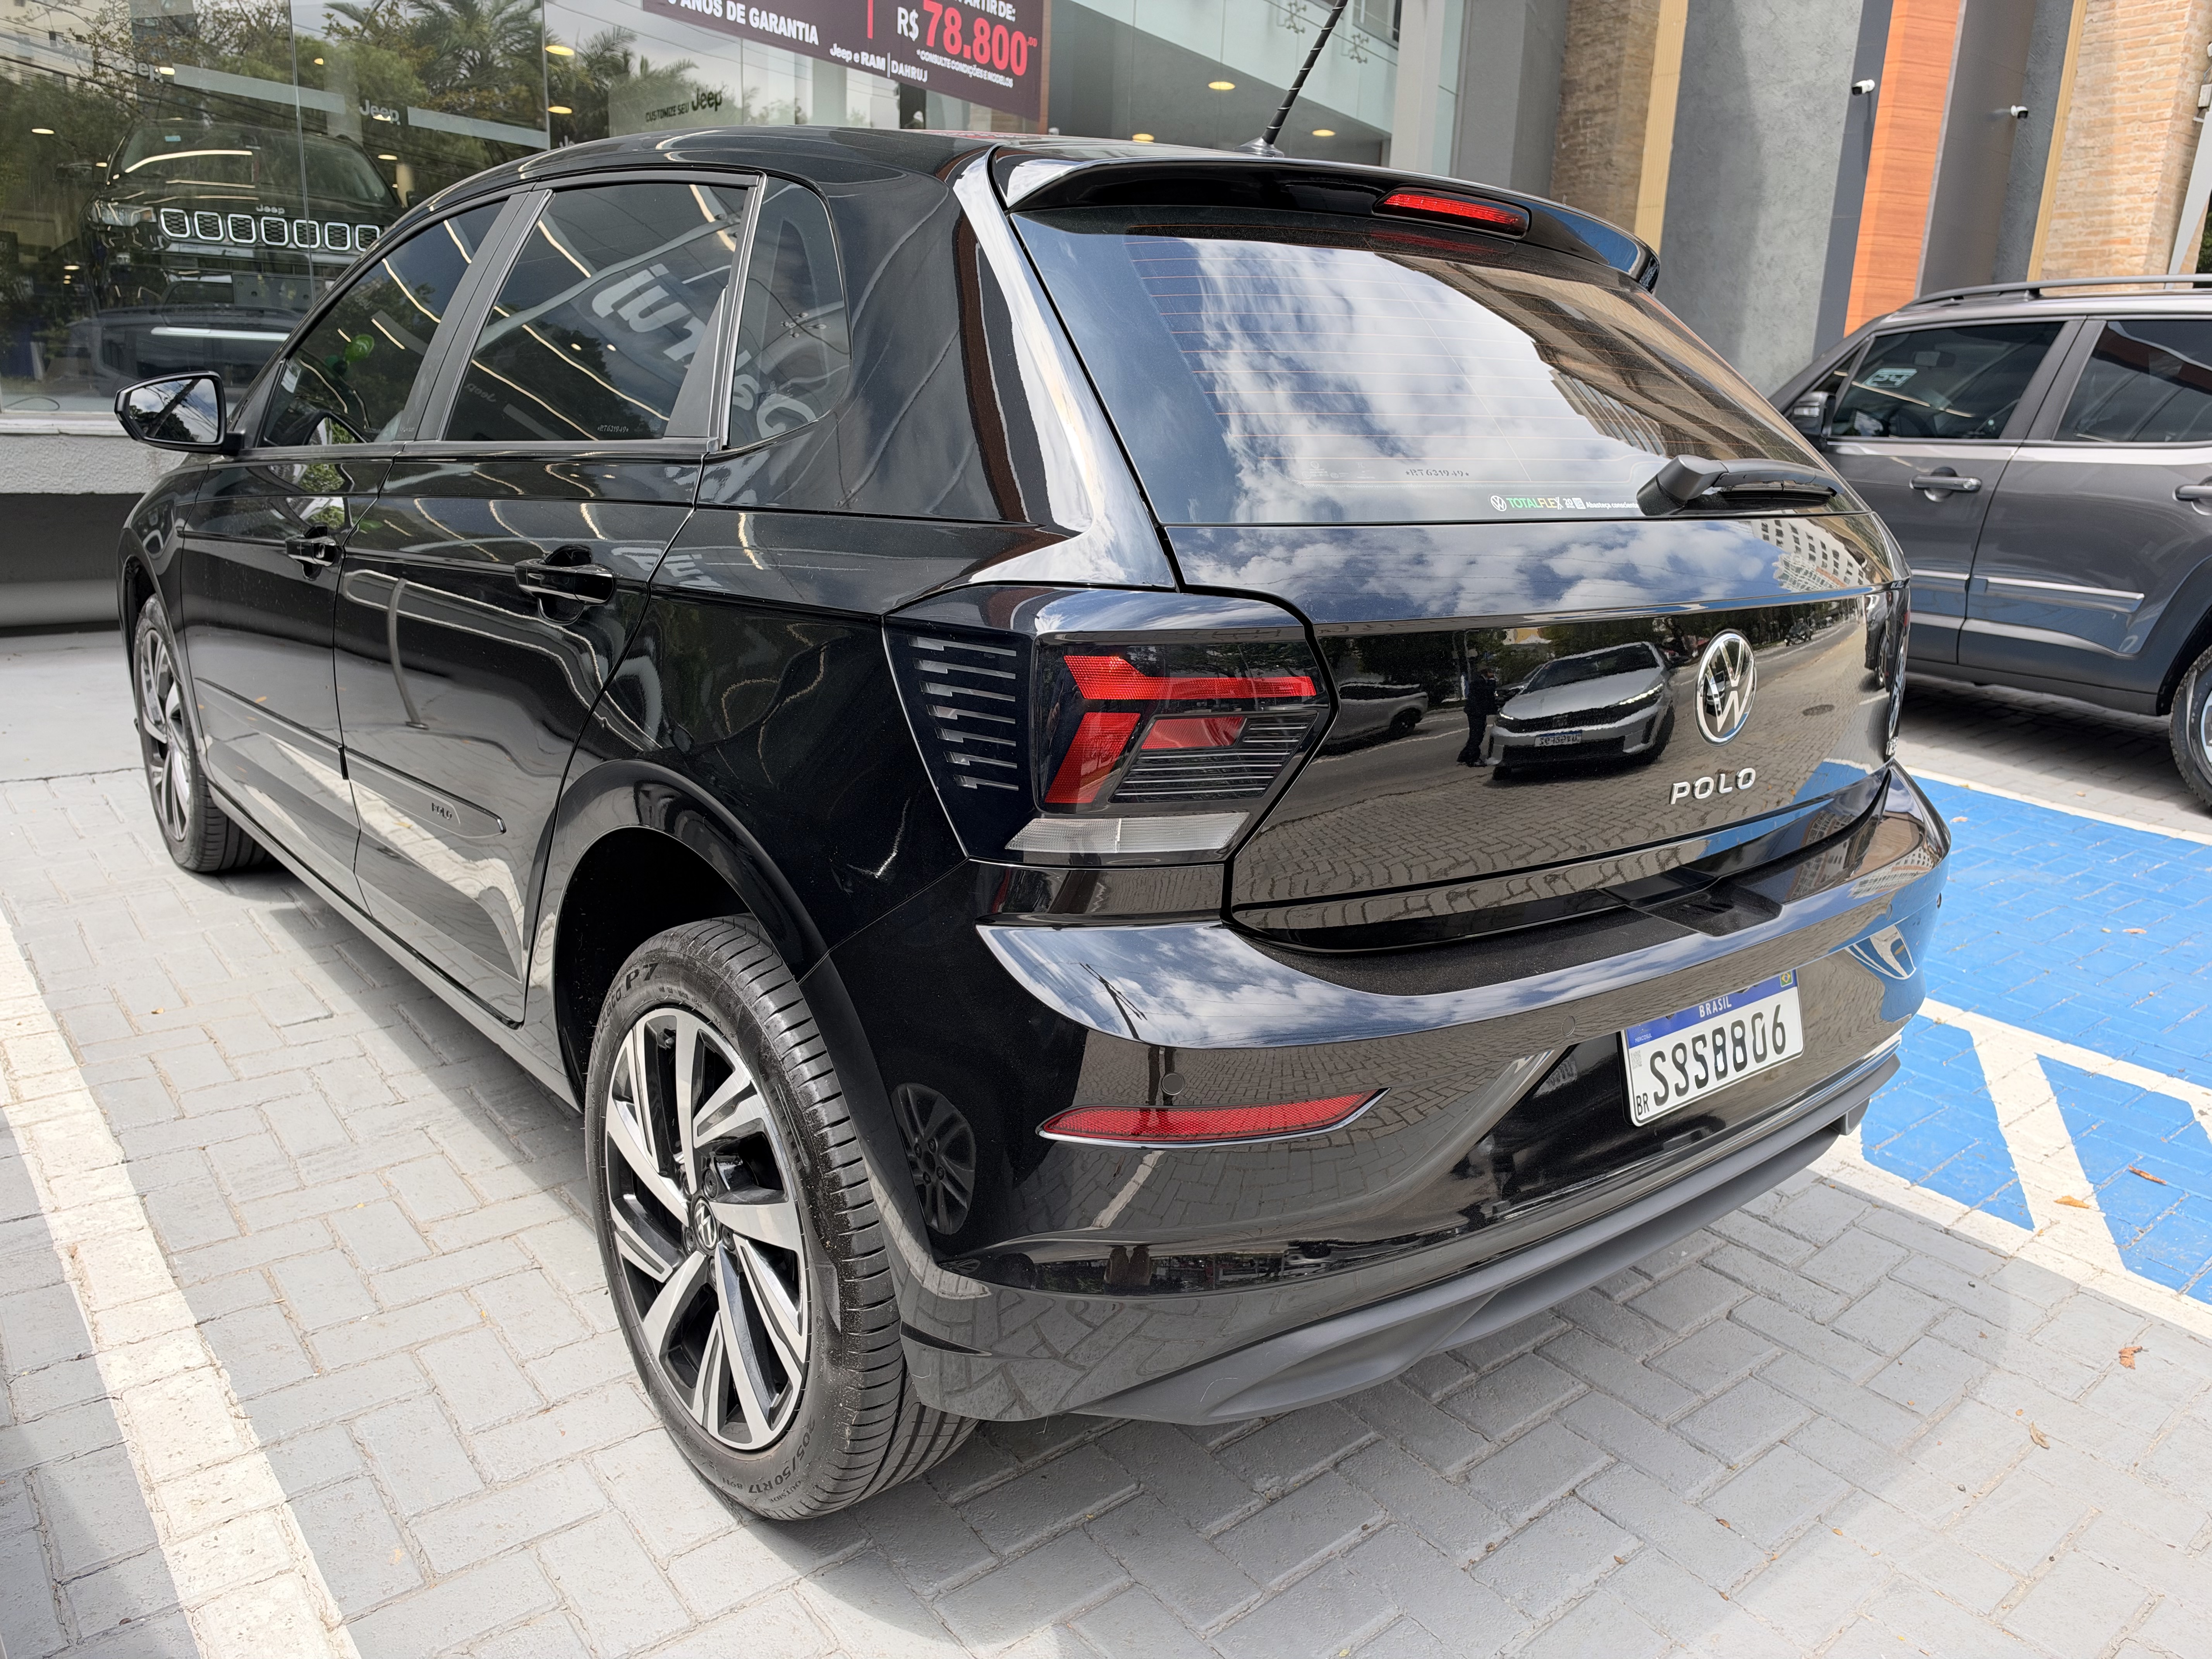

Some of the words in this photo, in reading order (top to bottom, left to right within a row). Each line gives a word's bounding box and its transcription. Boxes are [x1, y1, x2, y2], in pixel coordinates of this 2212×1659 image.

[958, 0, 997, 15] RTIR
[726, 0, 746, 24] DE
[749, 8, 819, 45] GARANTIA
[897, 7, 919, 41] R$
[924, 0, 1027, 76] 78.800
[830, 43, 852, 62] Jeep
[854, 53, 860, 63] e
[860, 52, 886, 71] RAM
[891, 60, 927, 82] DAHRUJ
[359, 100, 400, 124] Jeep
[646, 105, 677, 122] CUSTOMIZE
[678, 102, 689, 115] SEU
[692, 88, 722, 112] Jeep
[256, 204, 285, 215] Jeep
[1506, 496, 1564, 510] TOTALFLEX
[1669, 768, 1756, 805] POLO
[432, 802, 452, 820] POLO
[1699, 996, 1732, 1018] BRASIL
[1635, 1033, 1652, 1043] MERCOSUL
[1636, 1092, 1650, 1116] BR
[768, 1480, 802, 1503] OUTSIDE
